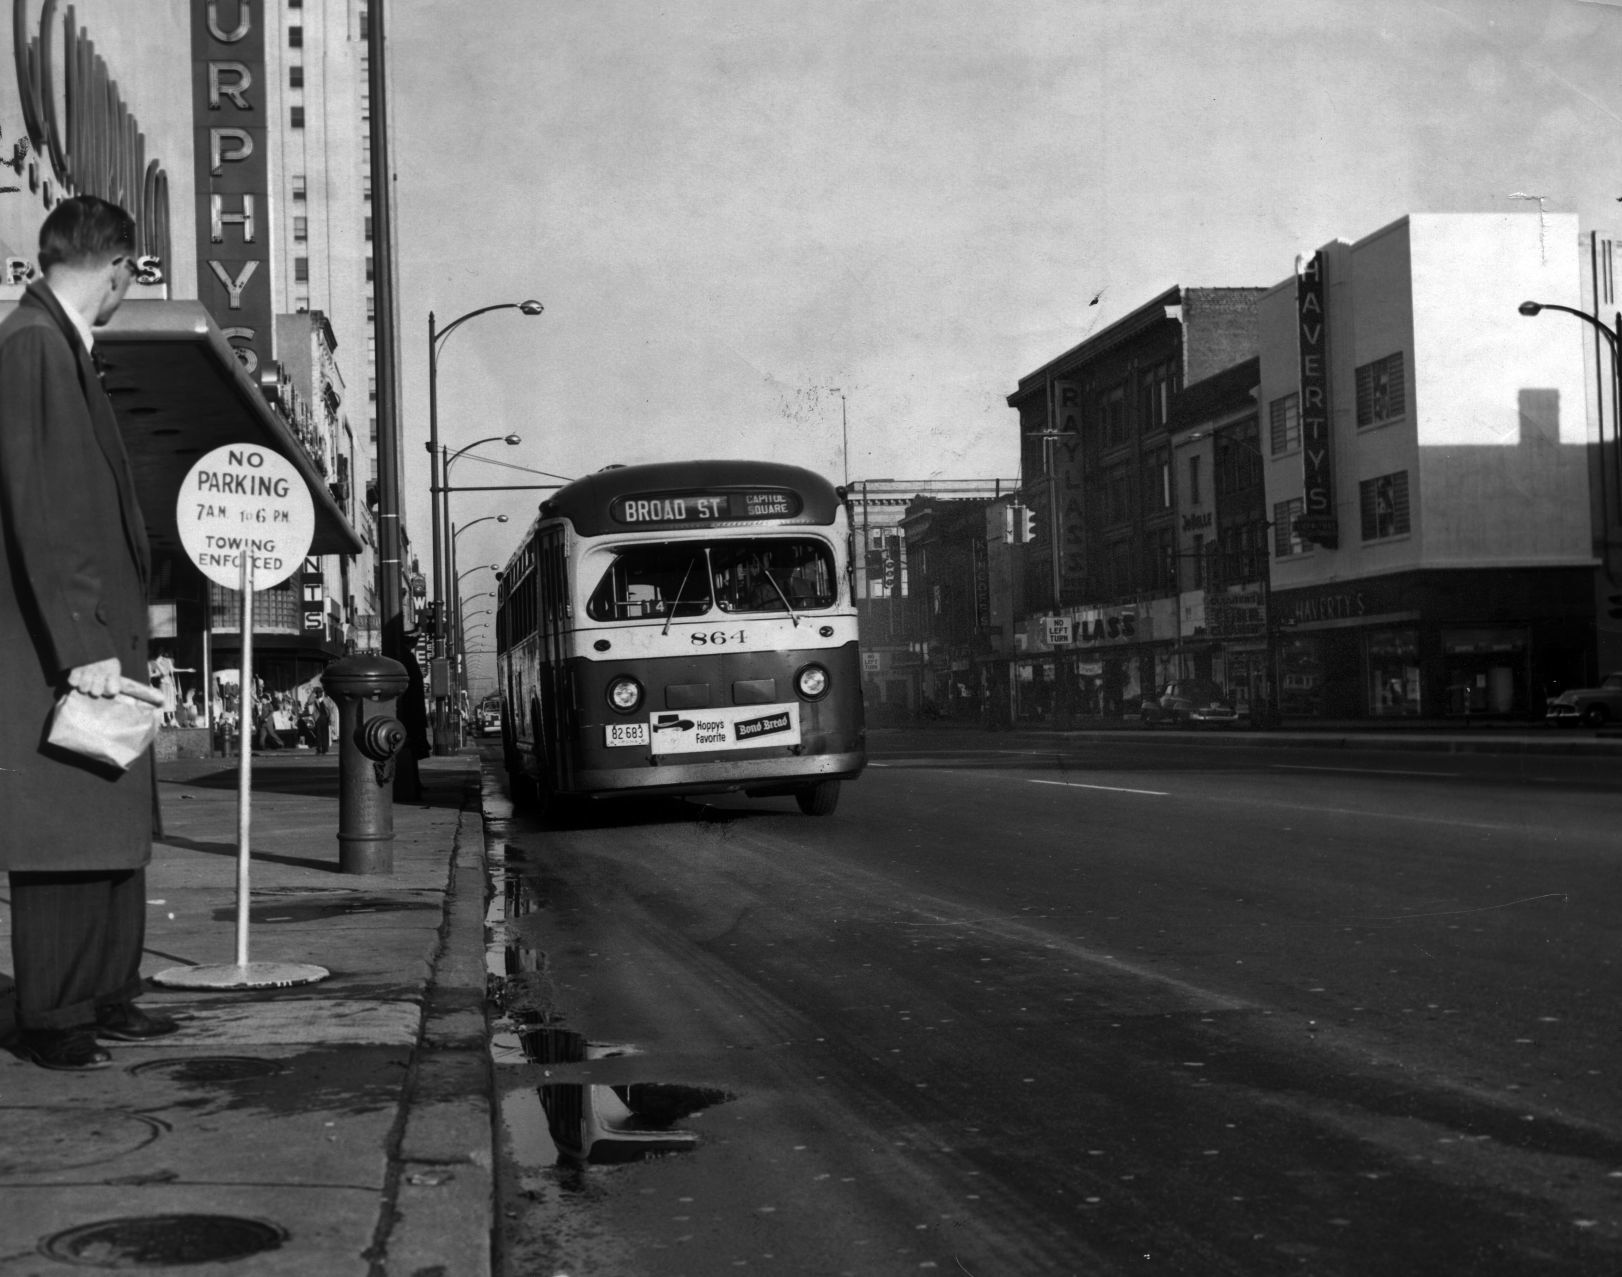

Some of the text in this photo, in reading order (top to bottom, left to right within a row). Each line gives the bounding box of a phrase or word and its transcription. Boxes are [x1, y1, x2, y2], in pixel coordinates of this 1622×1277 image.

[228, 450, 264, 468] NO
[197, 470, 290, 498] PARKING
[746, 494, 787, 504] CAPITOL
[256, 508, 266, 523] 6
[624, 498, 720, 522] BROAD ST
[747, 503, 789, 516] SQUARE
[205, 535, 276, 553] TOWING
[690, 630, 745, 646] 864
[1049, 627, 1068, 635] LEFT
[738, 715, 788, 735] Bond Bread
[612, 726, 644, 740] 82 683
[695, 733, 727, 744] Favorite
